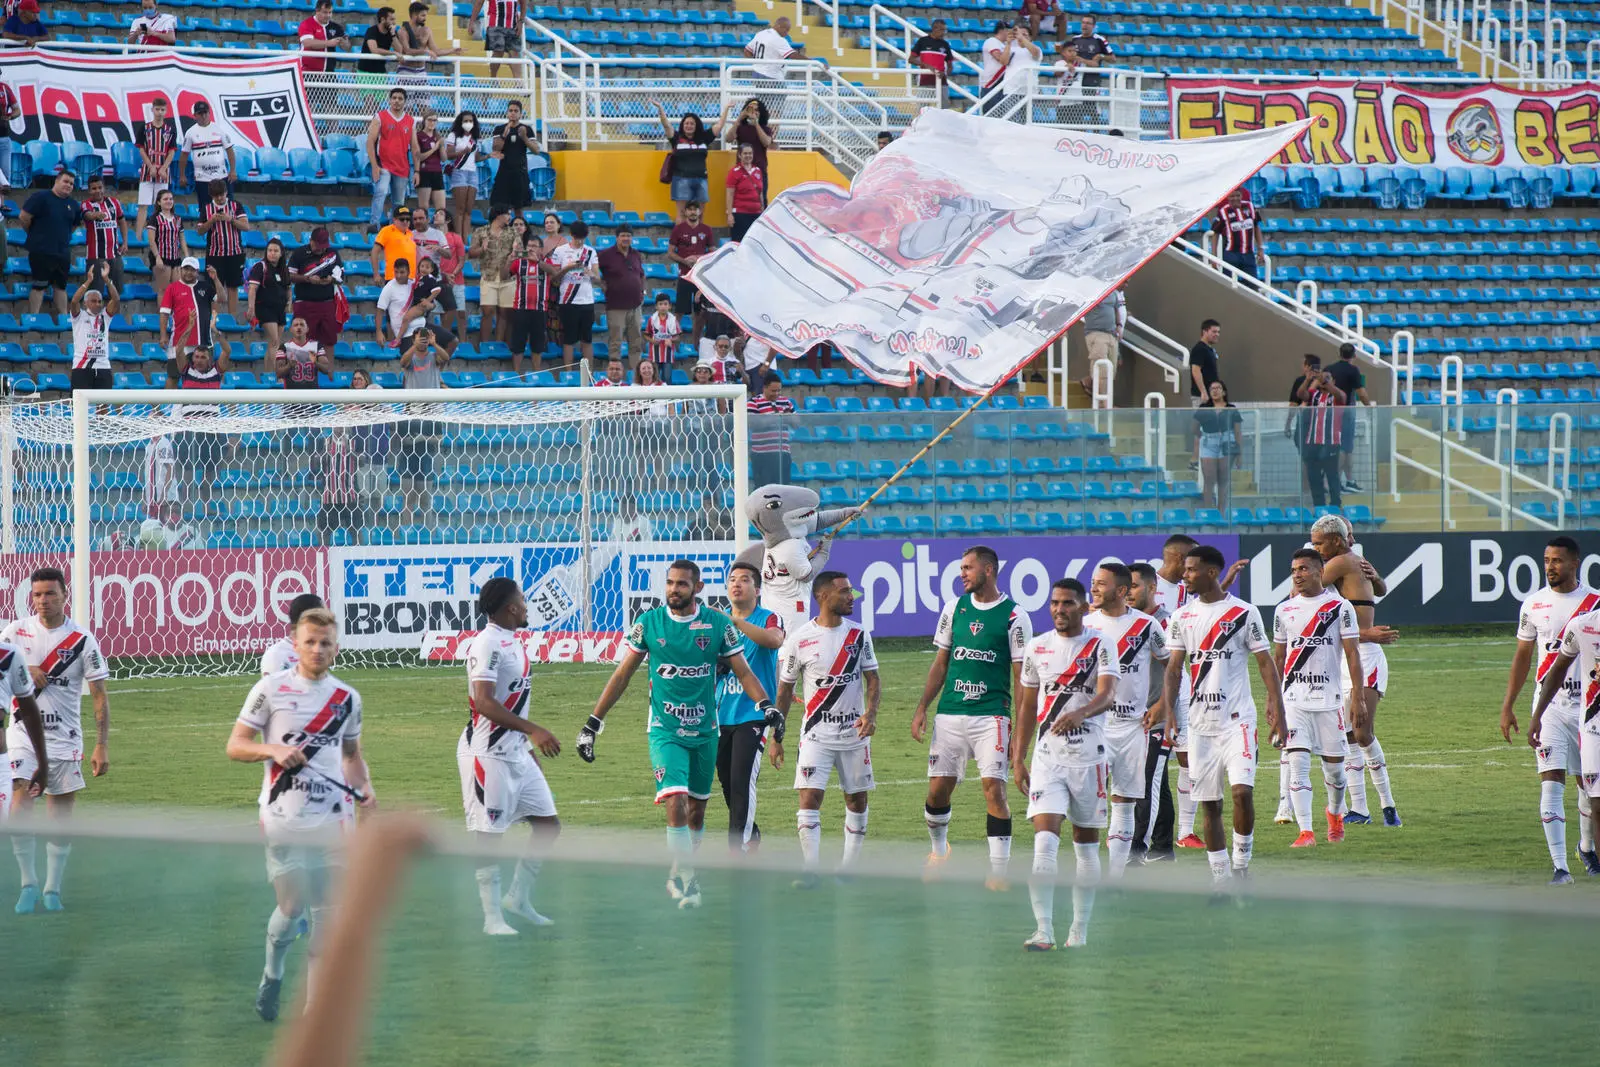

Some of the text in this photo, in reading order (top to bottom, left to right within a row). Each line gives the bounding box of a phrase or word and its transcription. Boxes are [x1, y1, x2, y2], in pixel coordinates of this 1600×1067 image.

[227, 97, 286, 118] FAC
[350, 562, 508, 598] TEK
[967, 650, 996, 662] zenir
[1205, 649, 1234, 661] zenir
[679, 662, 711, 677] zenir
[1120, 663, 1140, 674] enir
